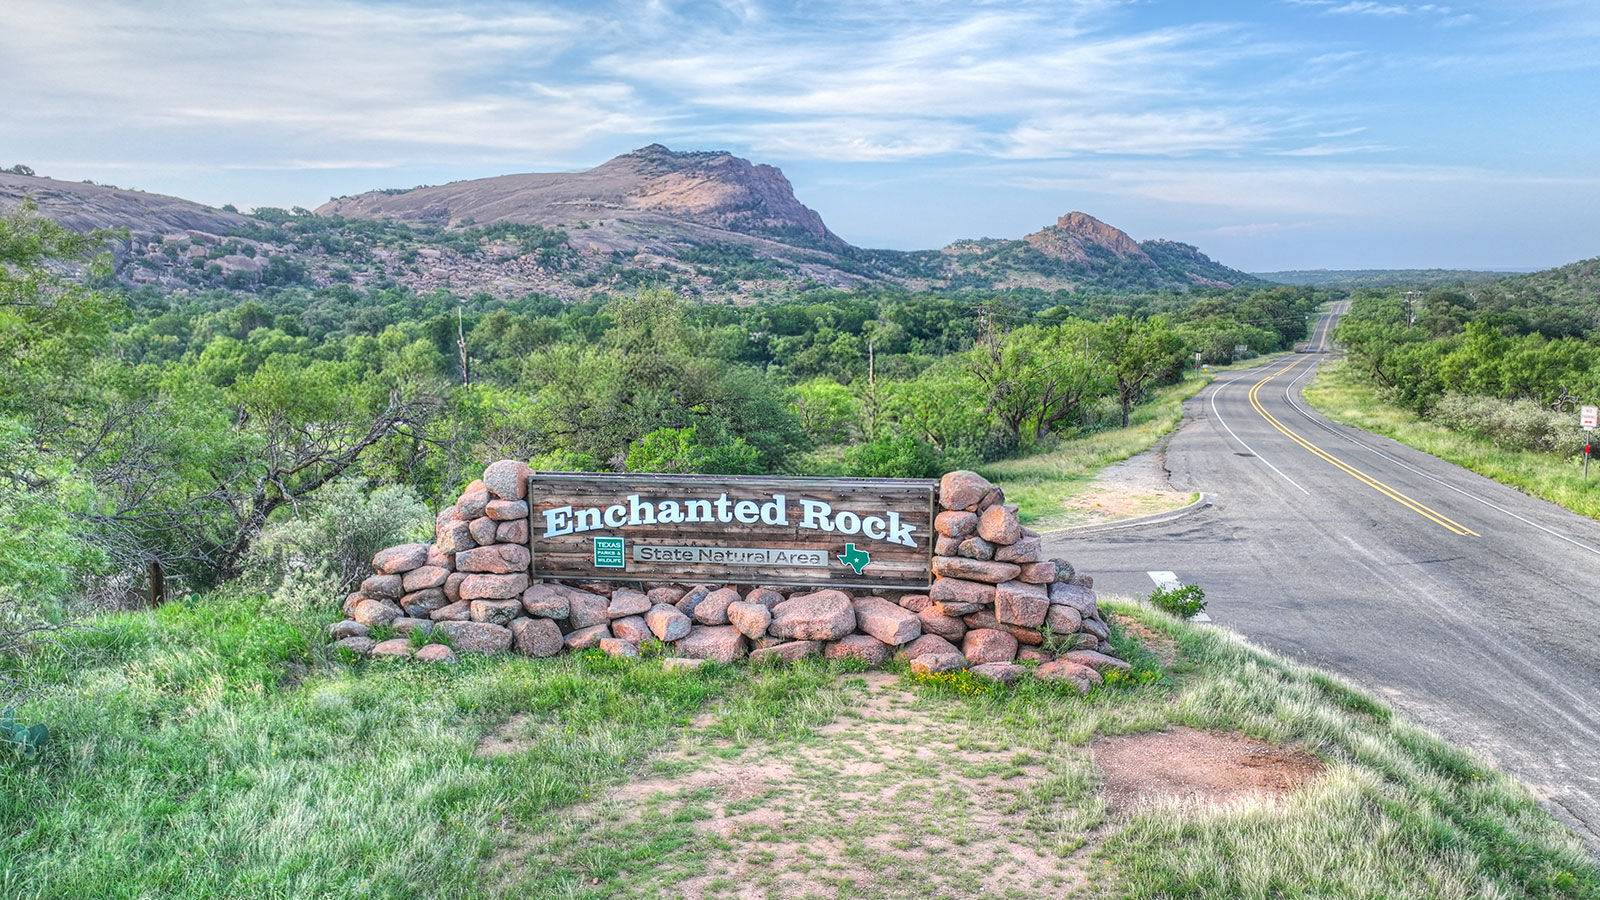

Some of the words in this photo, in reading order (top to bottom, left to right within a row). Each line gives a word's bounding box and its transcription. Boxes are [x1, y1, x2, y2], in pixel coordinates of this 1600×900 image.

[542, 493, 789, 539] Enchanted
[799, 499, 918, 548] Rock
[597, 541, 621, 549] TEXAS
[640, 547, 693, 562] State
[699, 548, 769, 564] Natural
[775, 552, 820, 565] Area
